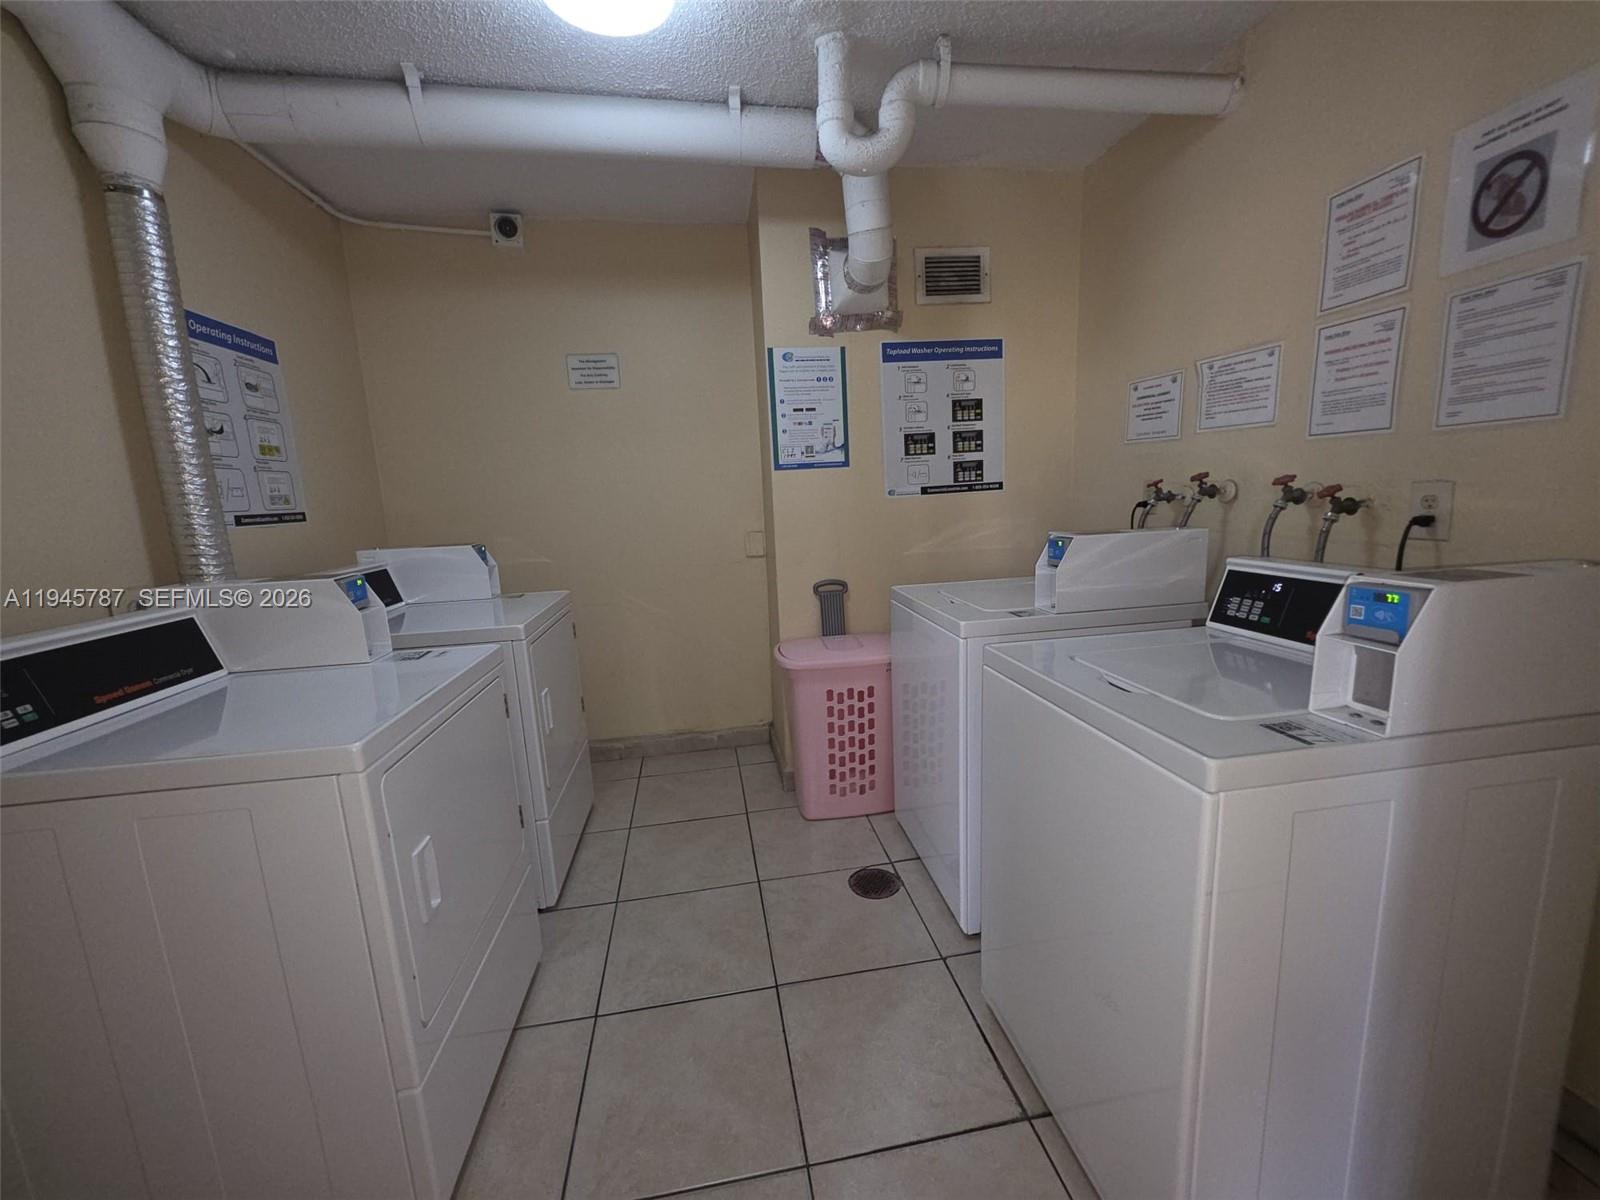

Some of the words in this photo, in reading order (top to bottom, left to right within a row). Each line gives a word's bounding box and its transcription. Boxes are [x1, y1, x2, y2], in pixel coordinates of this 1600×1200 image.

[188, 319, 232, 343] Operating
[233, 334, 273, 356] Instructions
[911, 347, 933, 355] Washer
[934, 346, 964, 355] Operating
[964, 345, 998, 353] Instructions
